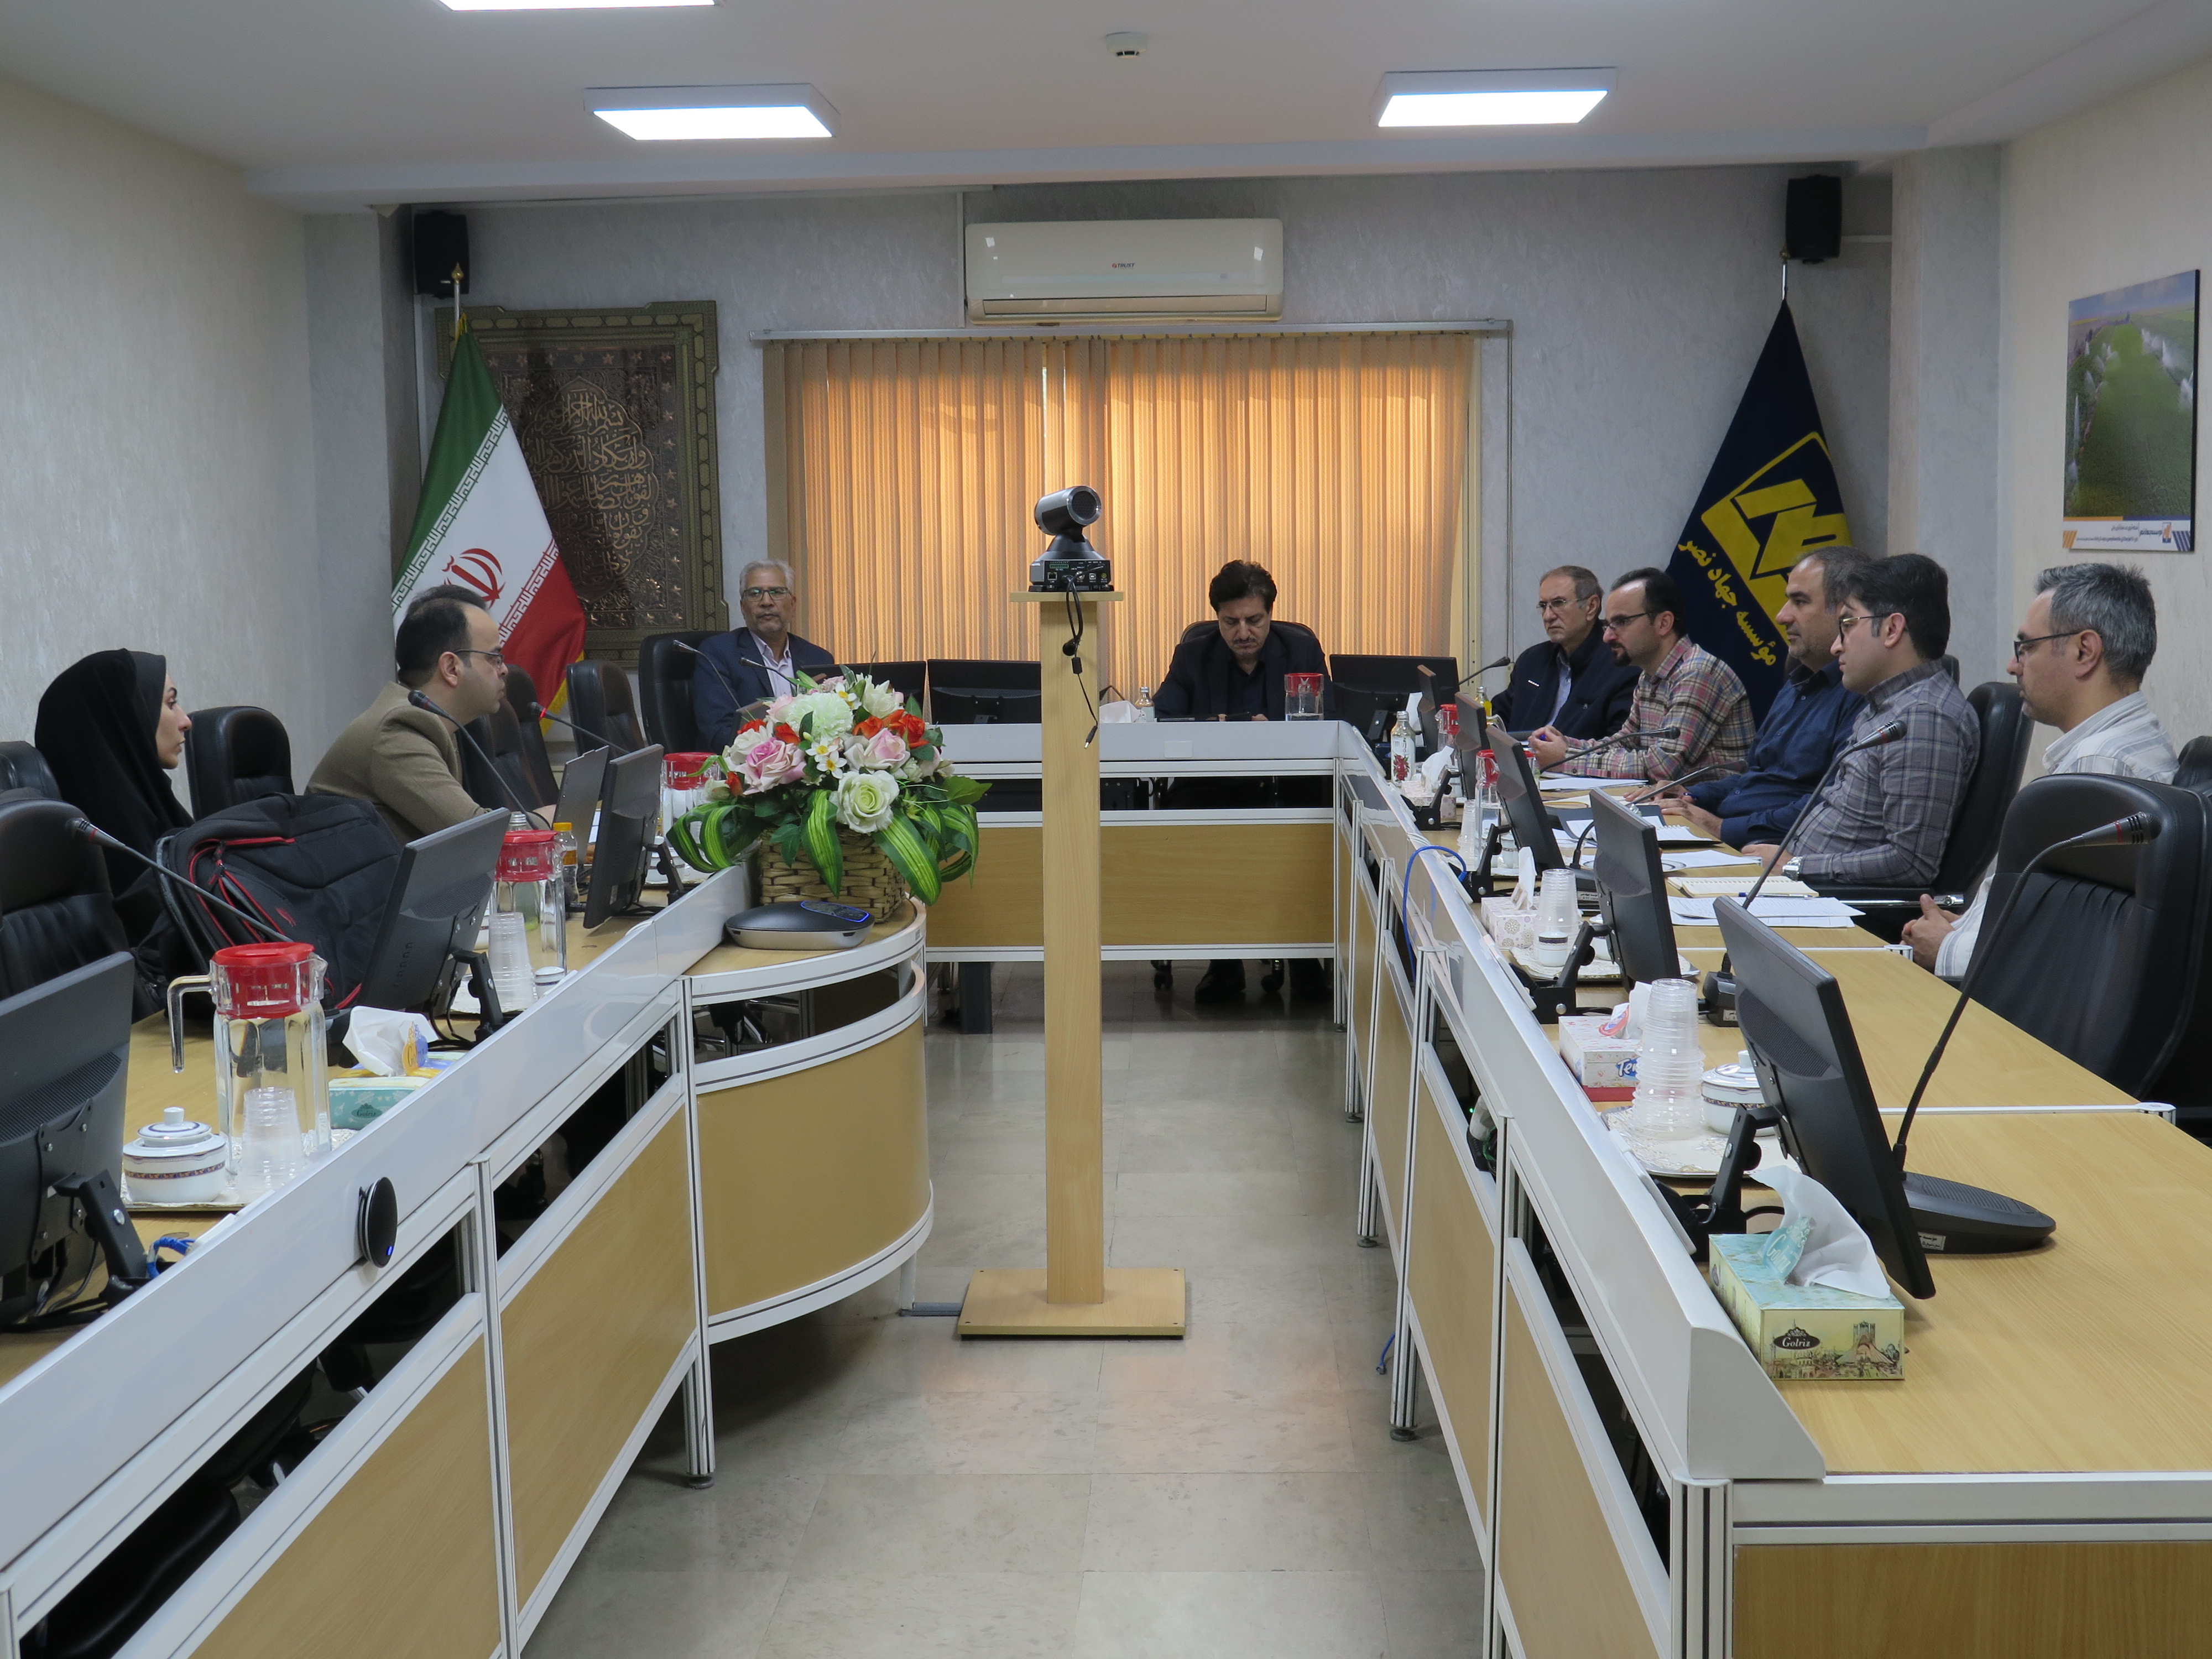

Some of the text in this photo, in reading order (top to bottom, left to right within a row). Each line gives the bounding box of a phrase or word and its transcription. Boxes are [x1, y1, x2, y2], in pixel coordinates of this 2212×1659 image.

[1677, 540, 1777, 666] مؤسسه جهاد نصر
[1782, 1336, 1812, 1349] Golriz
